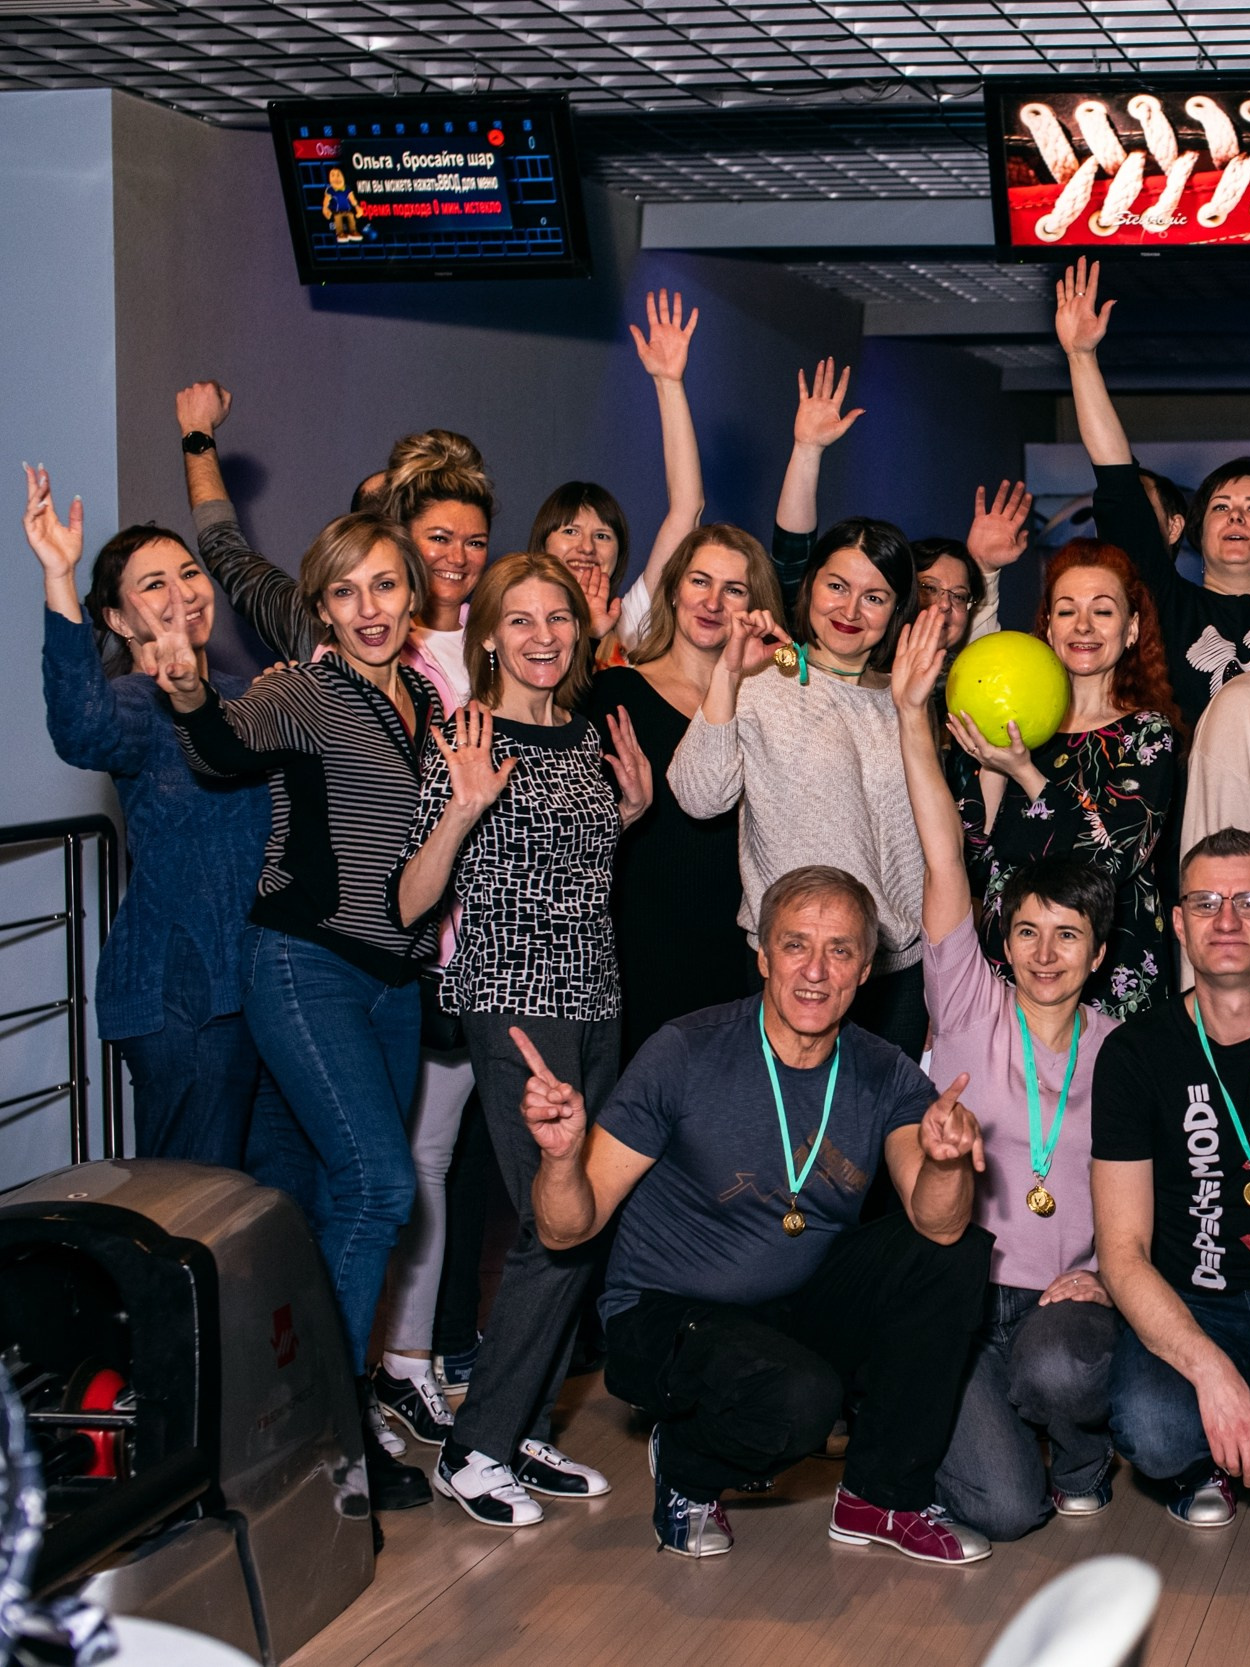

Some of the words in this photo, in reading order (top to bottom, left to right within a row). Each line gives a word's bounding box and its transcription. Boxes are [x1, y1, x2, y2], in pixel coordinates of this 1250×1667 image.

[352, 152, 394, 170] Ольга
[402, 150, 464, 172] бросайте
[467, 152, 495, 170] шар
[356, 180, 371, 194] или
[372, 180, 384, 193] вы
[385, 178, 412, 193] можете
[476, 176, 498, 190] меню
[360, 200, 392, 219] Время
[393, 202, 432, 218] подхода
[464, 201, 502, 216] истекло
[1183, 1083, 1225, 1178] MODE
